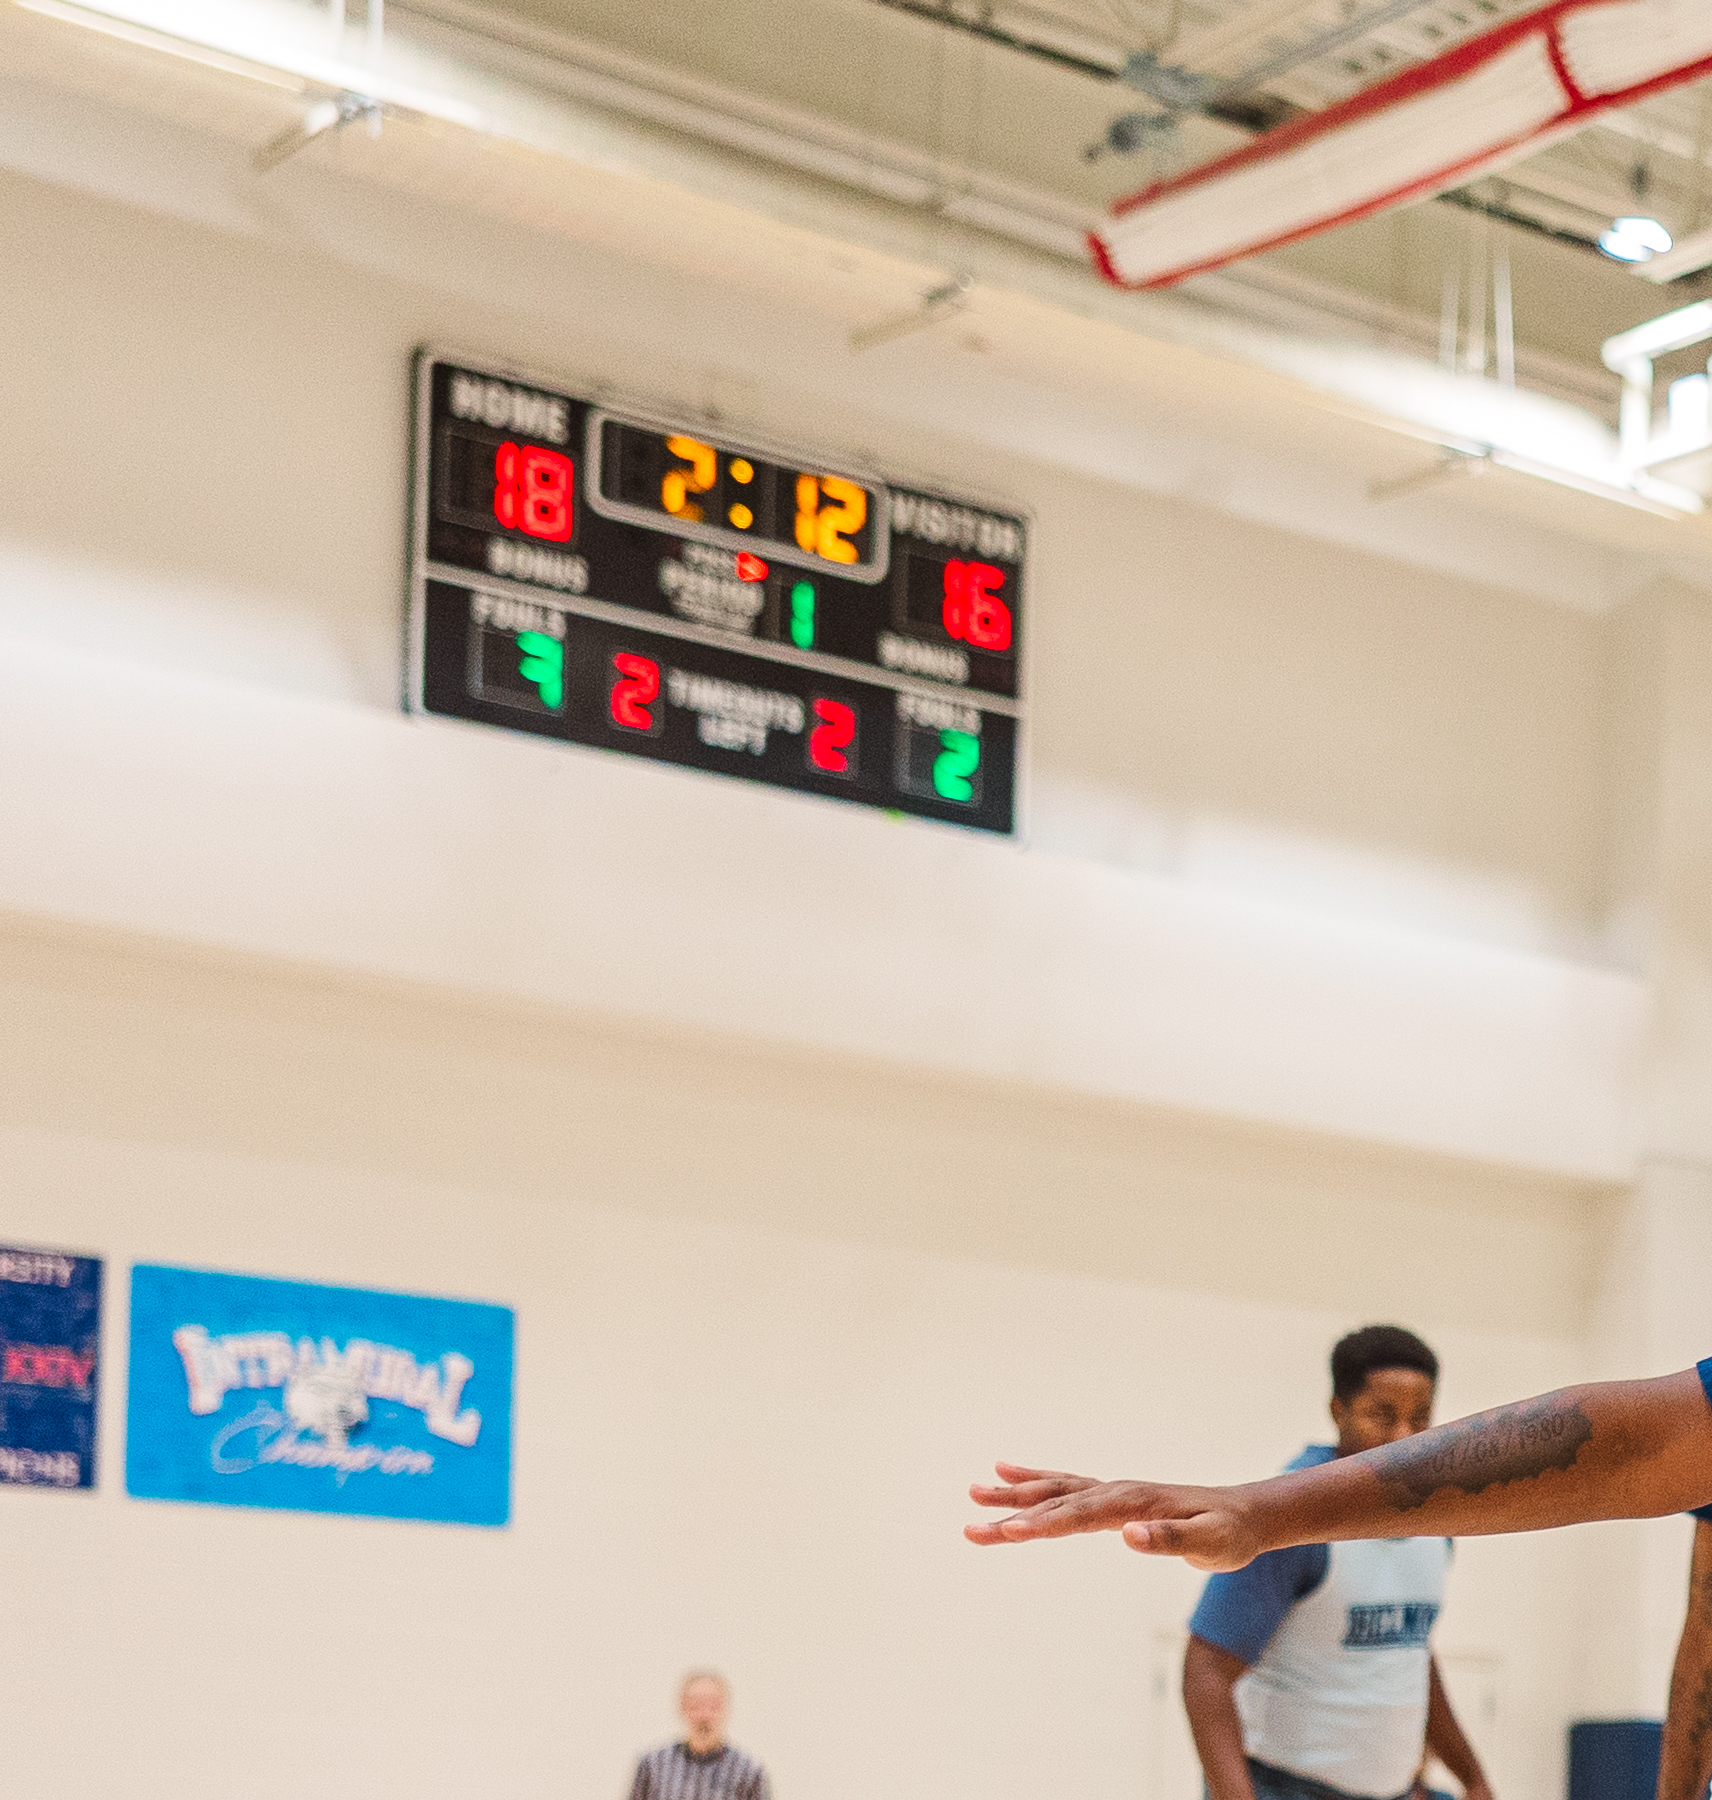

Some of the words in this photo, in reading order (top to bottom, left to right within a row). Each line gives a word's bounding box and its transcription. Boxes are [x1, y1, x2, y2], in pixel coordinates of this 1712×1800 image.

[451, 372, 570, 445] HOME
[493, 440, 574, 543] 18
[661, 434, 868, 565] 2:12
[789, 579, 816, 650] 1
[942, 558, 1012, 652] 16
[610, 651, 661, 731] 2
[808, 697, 856, 774] 2
[932, 728, 982, 803] 2
